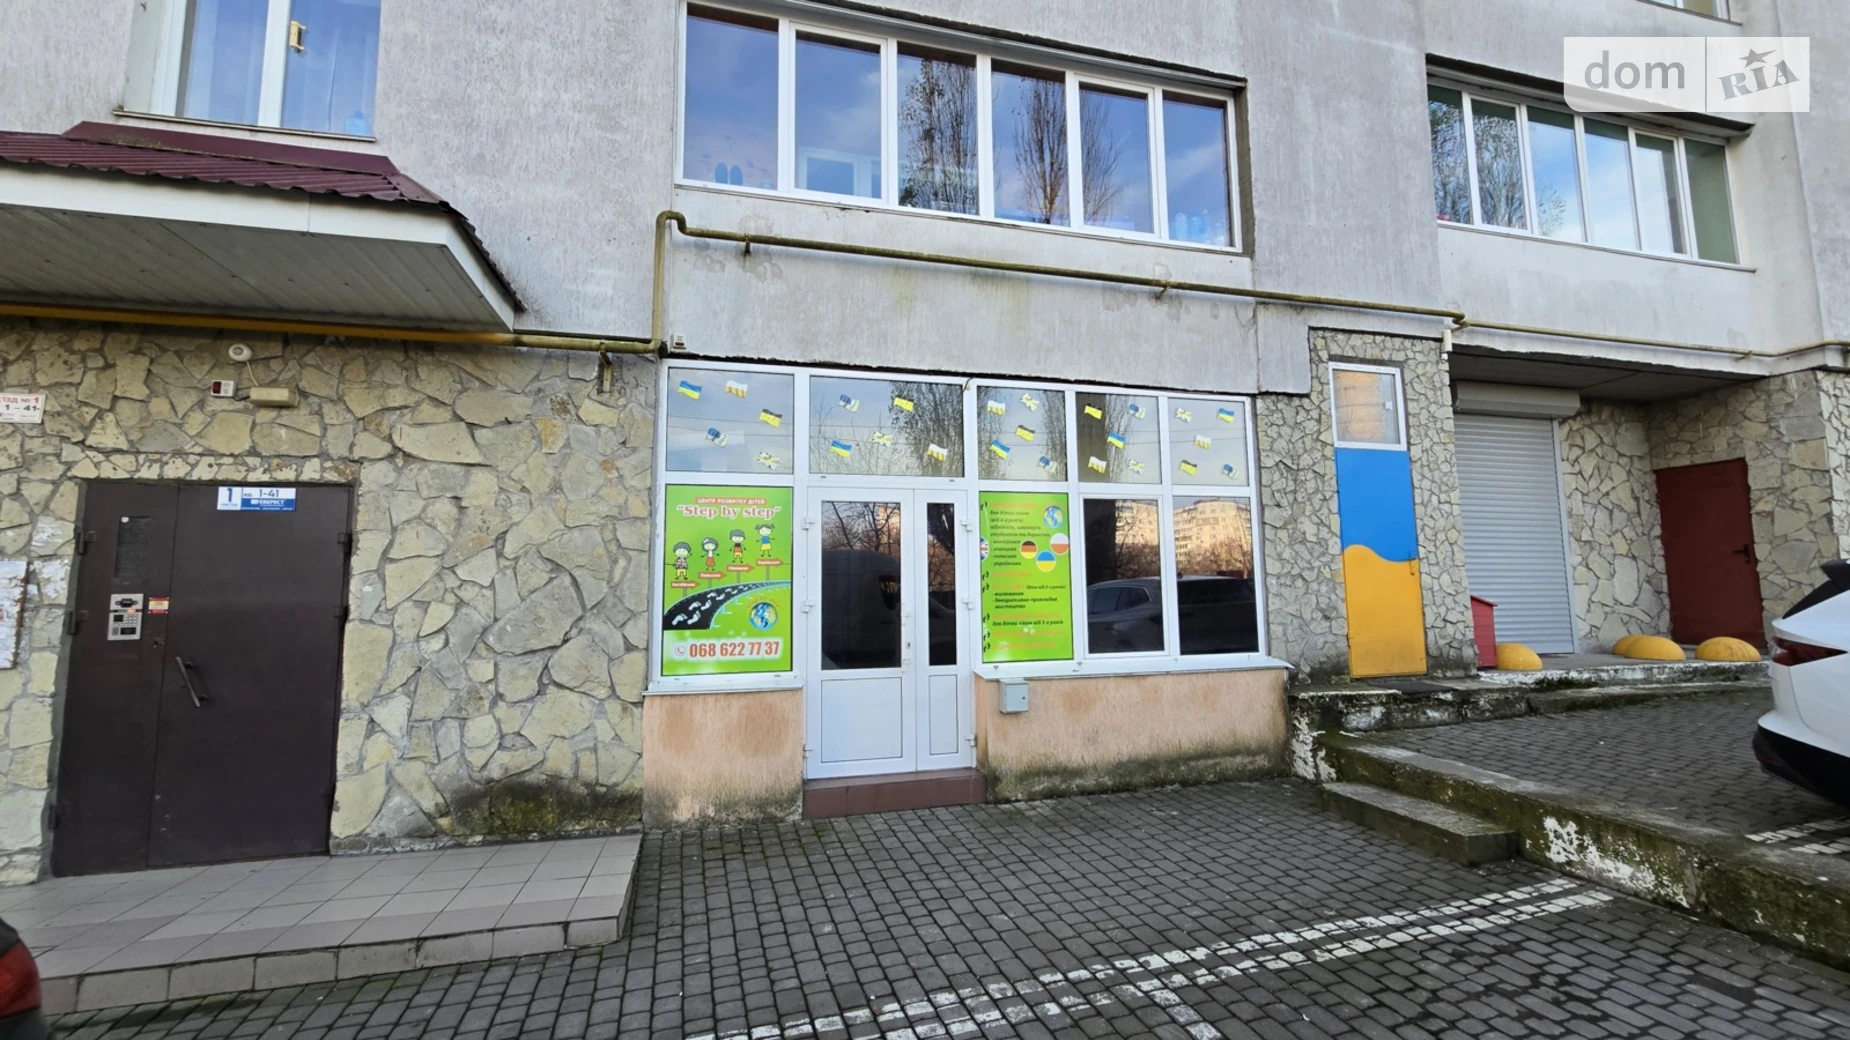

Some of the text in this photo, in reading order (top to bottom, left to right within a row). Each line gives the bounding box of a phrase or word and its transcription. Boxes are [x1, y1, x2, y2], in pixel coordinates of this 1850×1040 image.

[227, 487, 233, 503] 1
[259, 489, 280, 497] 1-41
[722, 506, 739, 519] by
[689, 641, 780, 658] 068 622 77 37
